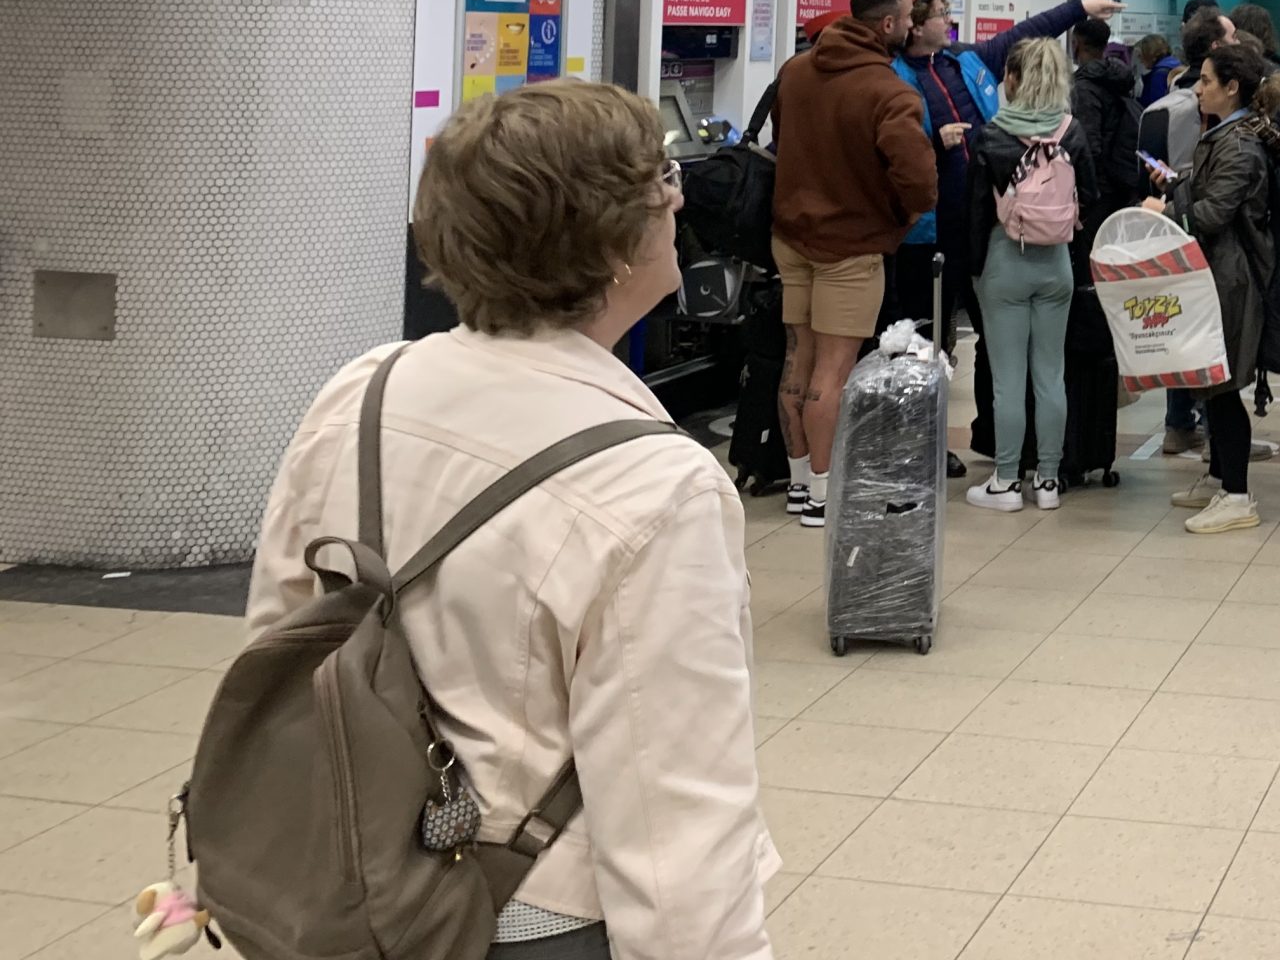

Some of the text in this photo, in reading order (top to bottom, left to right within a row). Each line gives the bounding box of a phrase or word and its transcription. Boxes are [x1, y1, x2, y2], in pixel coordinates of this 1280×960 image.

[667, 5, 732, 18] PASSE NAVIGO EASY
